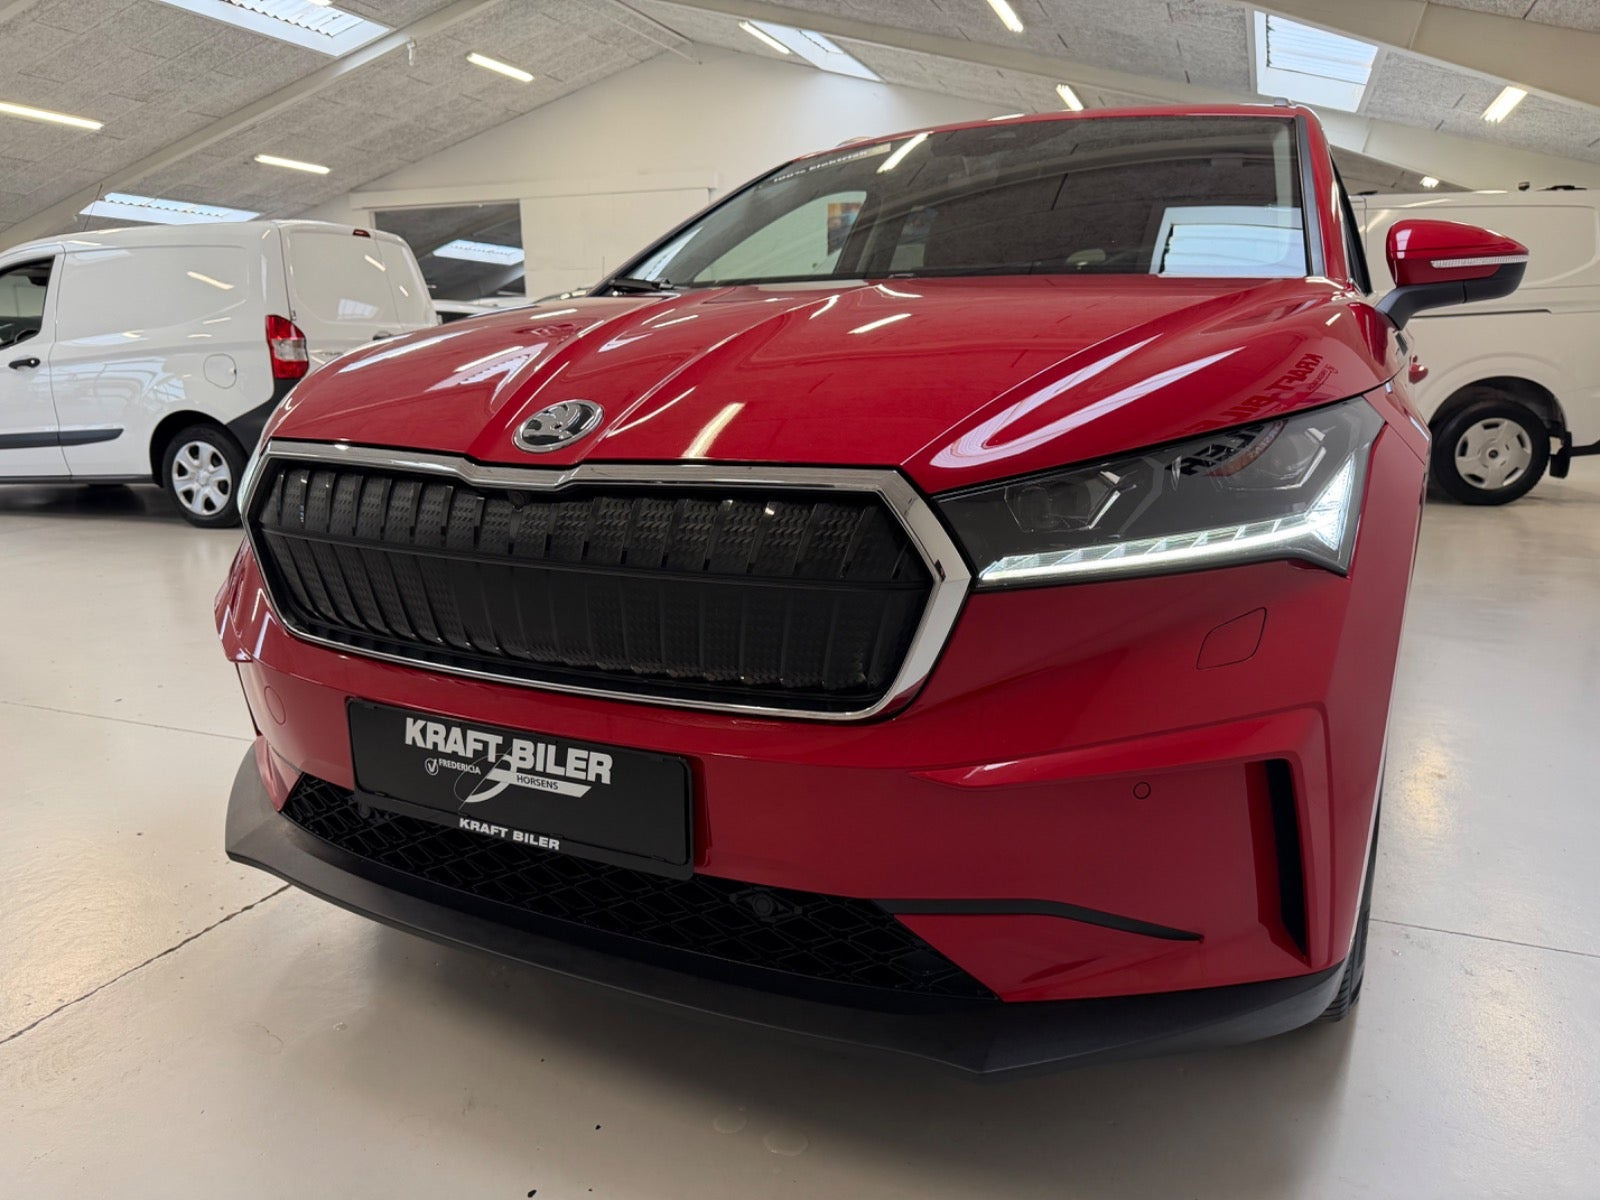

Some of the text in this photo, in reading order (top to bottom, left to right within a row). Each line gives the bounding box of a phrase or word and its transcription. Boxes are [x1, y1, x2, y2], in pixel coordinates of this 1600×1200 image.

[405, 717, 613, 784] KRAFT BILER
[438, 758, 482, 775] FREDERICIA
[516, 774, 559, 790] HORSENS
[459, 817, 561, 850] KRAFT BILER
